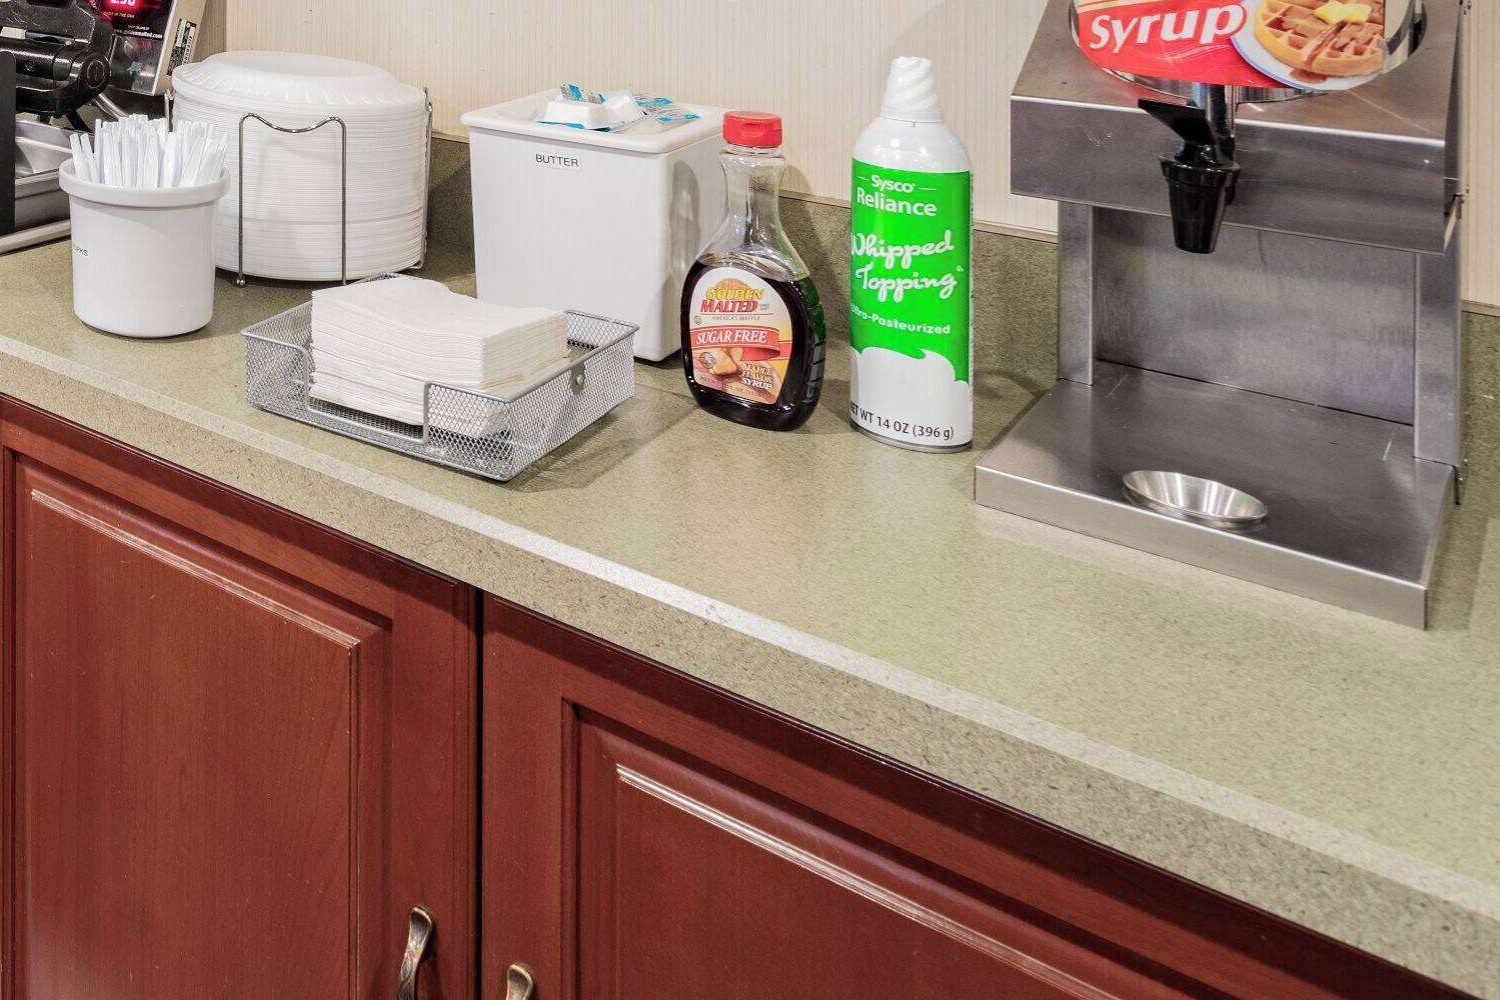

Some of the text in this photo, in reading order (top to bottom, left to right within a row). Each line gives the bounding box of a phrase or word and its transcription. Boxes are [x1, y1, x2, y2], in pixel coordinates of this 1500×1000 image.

[1089, 3, 1245, 54] Syrup
[534, 153, 580, 168] BUTTER
[871, 174, 914, 194] Sysco
[857, 186, 938, 217] Reliance
[855, 261, 958, 303] Topping
[706, 286, 765, 300] GOLDEN
[700, 299, 760, 313] MALTED
[696, 329, 768, 345] SUGAR FREE
[741, 377, 774, 390] SYRUP
[860, 408, 874, 424] WT
[877, 416, 891, 429] 14
[893, 421, 909, 434] OZ
[912, 424, 941, 438] (396
[943, 426, 955, 441] g)
